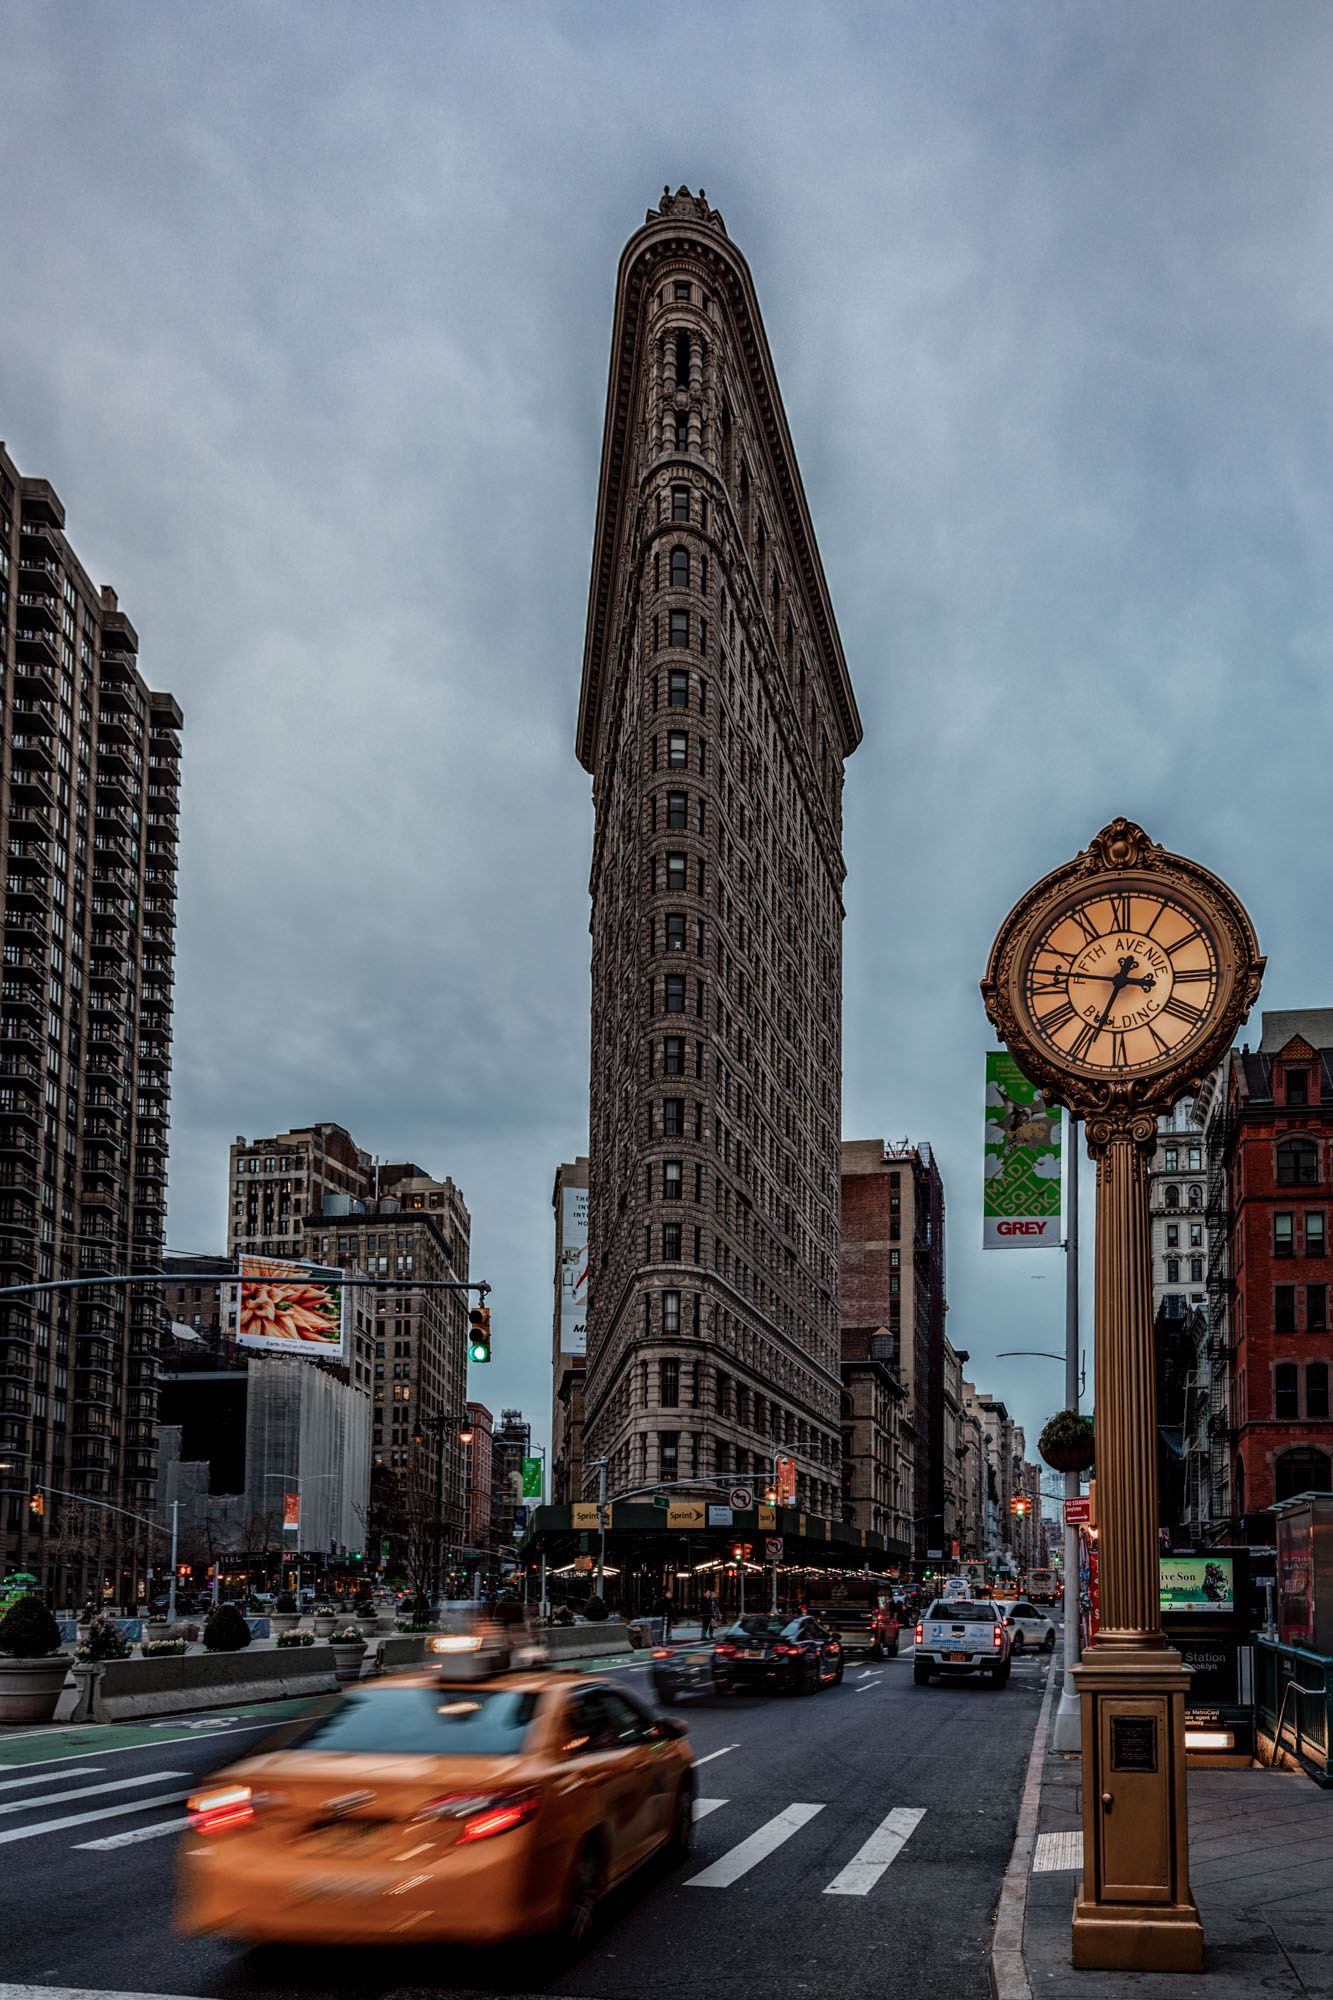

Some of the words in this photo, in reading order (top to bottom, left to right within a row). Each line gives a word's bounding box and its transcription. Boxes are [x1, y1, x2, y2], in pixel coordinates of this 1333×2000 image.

[1073, 944, 1107, 984] FFTH
[1115, 938, 1169, 978] AVENUE
[1083, 999, 1161, 1029] BLDING
[986, 1164, 1028, 1199] MAD.
[1002, 1190, 1032, 1213] SQ.
[1030, 1192, 1060, 1216] PK.
[997, 1221, 1048, 1235] GREY
[577, 1512, 599, 1520] Sprint
[670, 1511, 692, 1520] Sprint
[1161, 1572, 1175, 1580] ive
[1177, 1571, 1196, 1580] Son
[1185, 1652, 1226, 1662] Station
[1192, 1663, 1218, 1671] ooklyn
